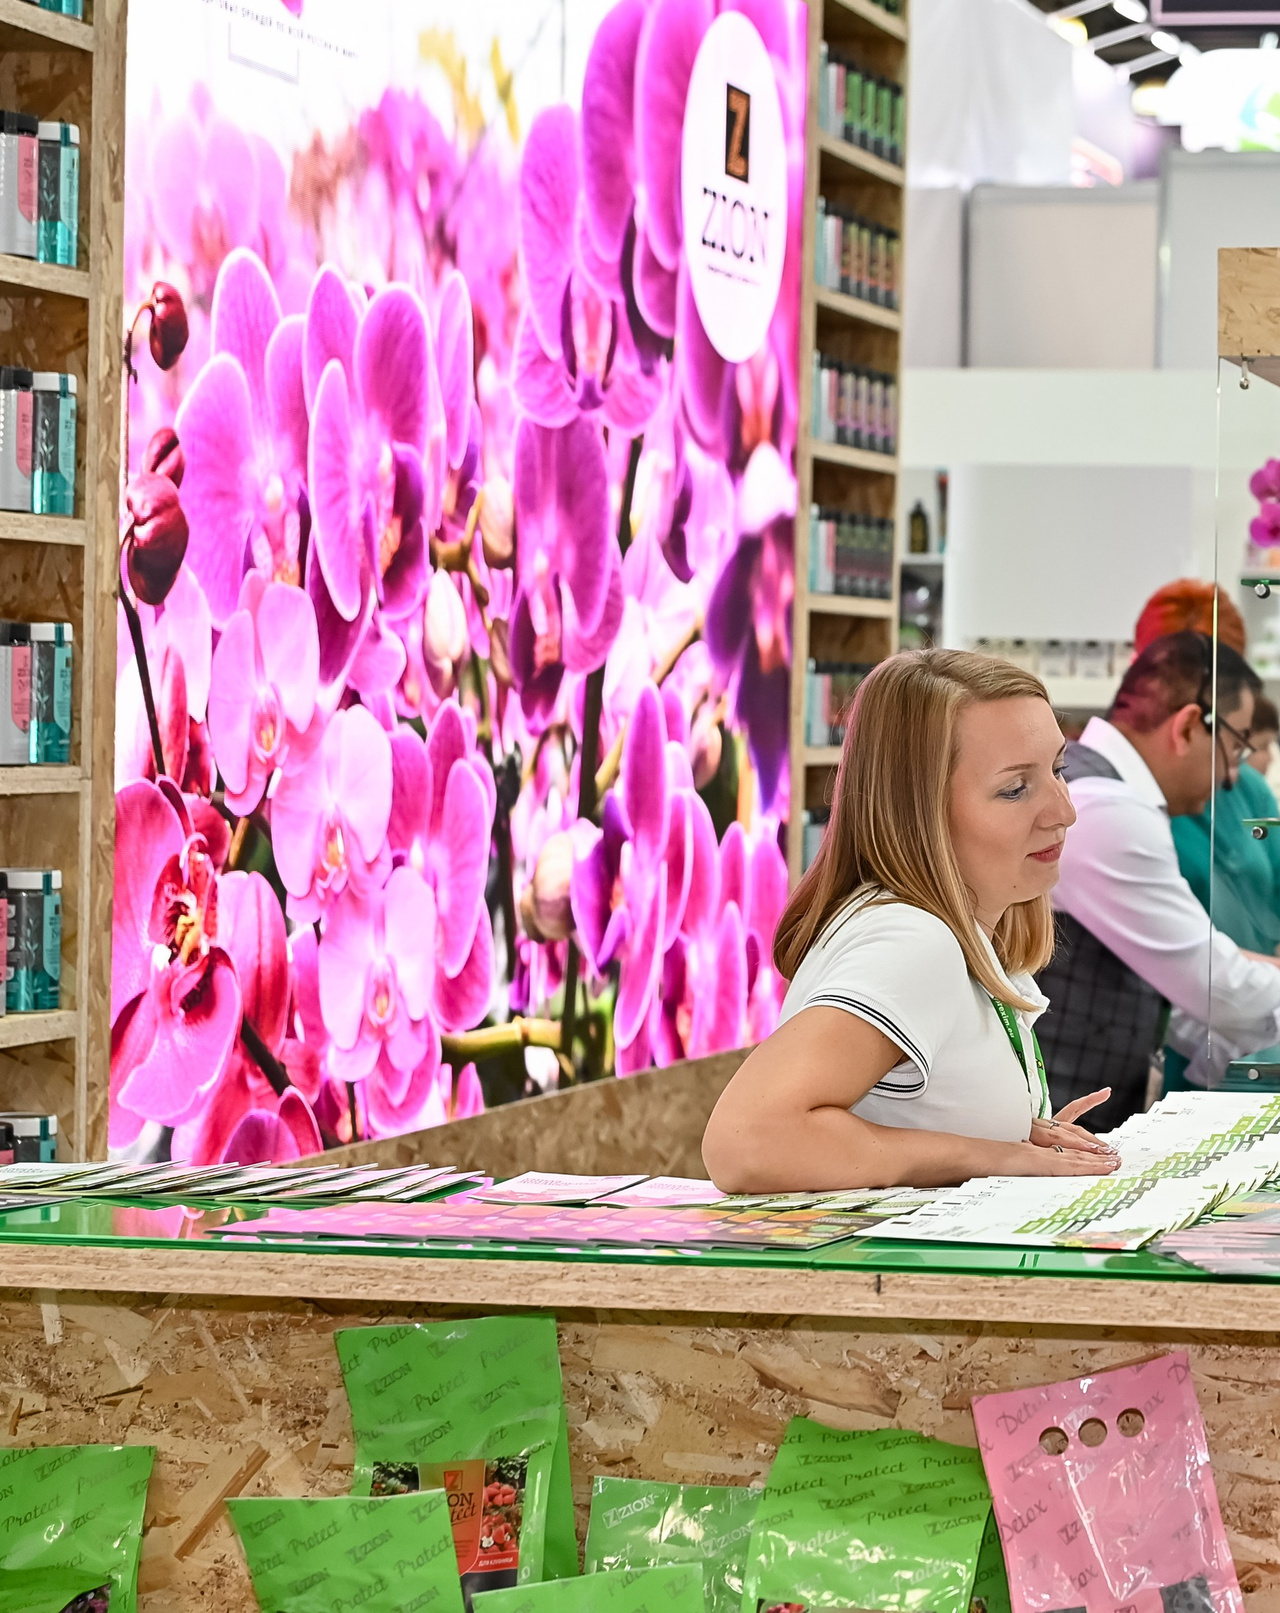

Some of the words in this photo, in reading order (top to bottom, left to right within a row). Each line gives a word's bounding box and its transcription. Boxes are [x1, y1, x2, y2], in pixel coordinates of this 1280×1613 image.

[701, 186, 769, 264] ZION
[382, 1362, 413, 1389] ZION
[418, 1420, 454, 1448] ZION
[813, 1453, 854, 1464] ZION
[763, 1477, 827, 1501] Protect
[843, 1462, 908, 1487] Protect
[921, 1453, 981, 1470] Protec
[914, 1477, 957, 1494] ZION
[1, 1494, 62, 1533] Protect
[618, 1494, 656, 1522] ZION
[834, 1490, 877, 1510] ZION
[866, 1502, 931, 1526] Protect
[941, 1513, 983, 1533] ZION
[1000, 1499, 1048, 1544] Detox
[287, 1519, 343, 1556] Protect
[361, 1529, 394, 1558] ZION
[330, 1575, 390, 1613] Protect
[393, 1534, 453, 1579] Protect
[478, 1558, 490, 1567] ДЛЯ
[489, 1556, 514, 1566] КЛУБНИКИ
